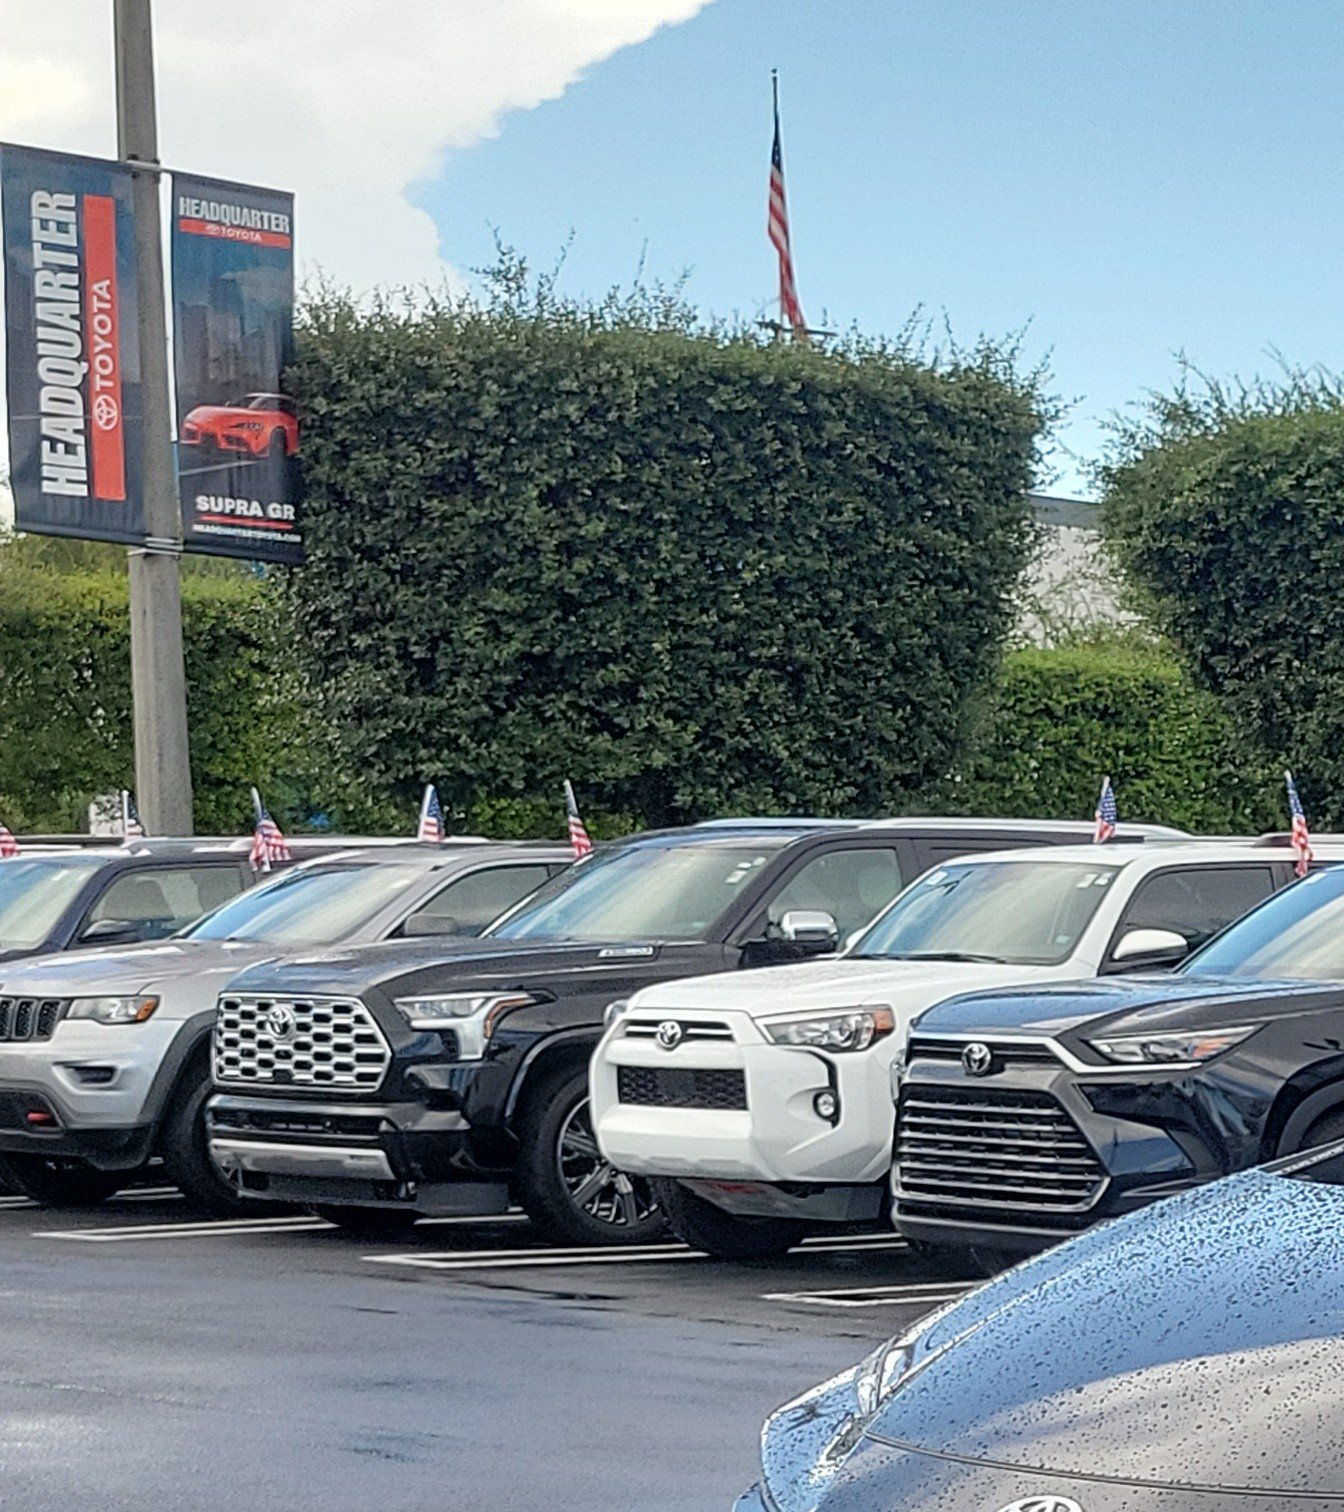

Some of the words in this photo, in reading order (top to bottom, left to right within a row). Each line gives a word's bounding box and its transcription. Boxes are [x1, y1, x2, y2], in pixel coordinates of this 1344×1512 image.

[179, 196, 290, 234] HEADQUARTER
[221, 227, 263, 242] TOYOTA
[31, 190, 89, 498] HEADQUARTER
[91, 279, 114, 392] TOYOTA
[196, 495, 264, 517] SUPRA
[266, 502, 296, 521] GR
